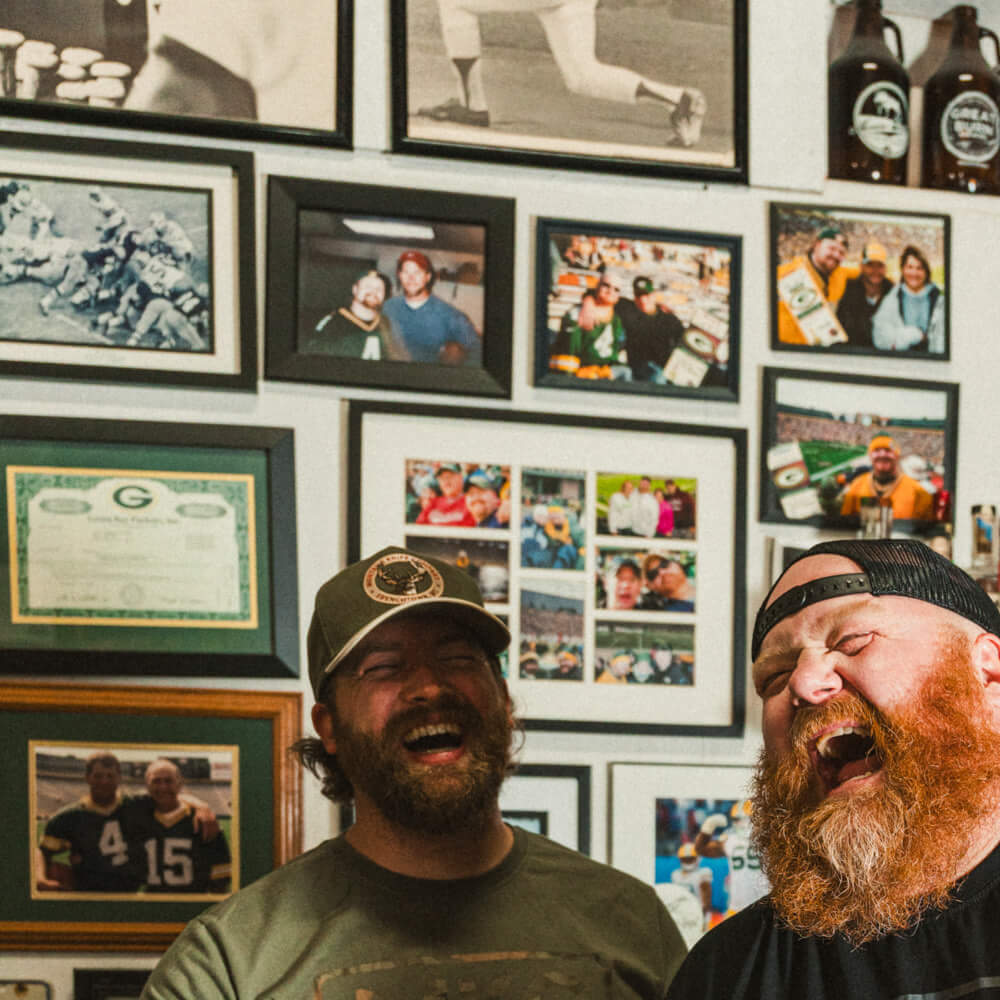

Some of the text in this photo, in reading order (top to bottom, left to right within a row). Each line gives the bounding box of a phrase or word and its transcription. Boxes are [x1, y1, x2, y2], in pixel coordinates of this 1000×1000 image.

[113, 484, 153, 510] G
[99, 820, 129, 866] 4
[144, 838, 193, 886] 15
